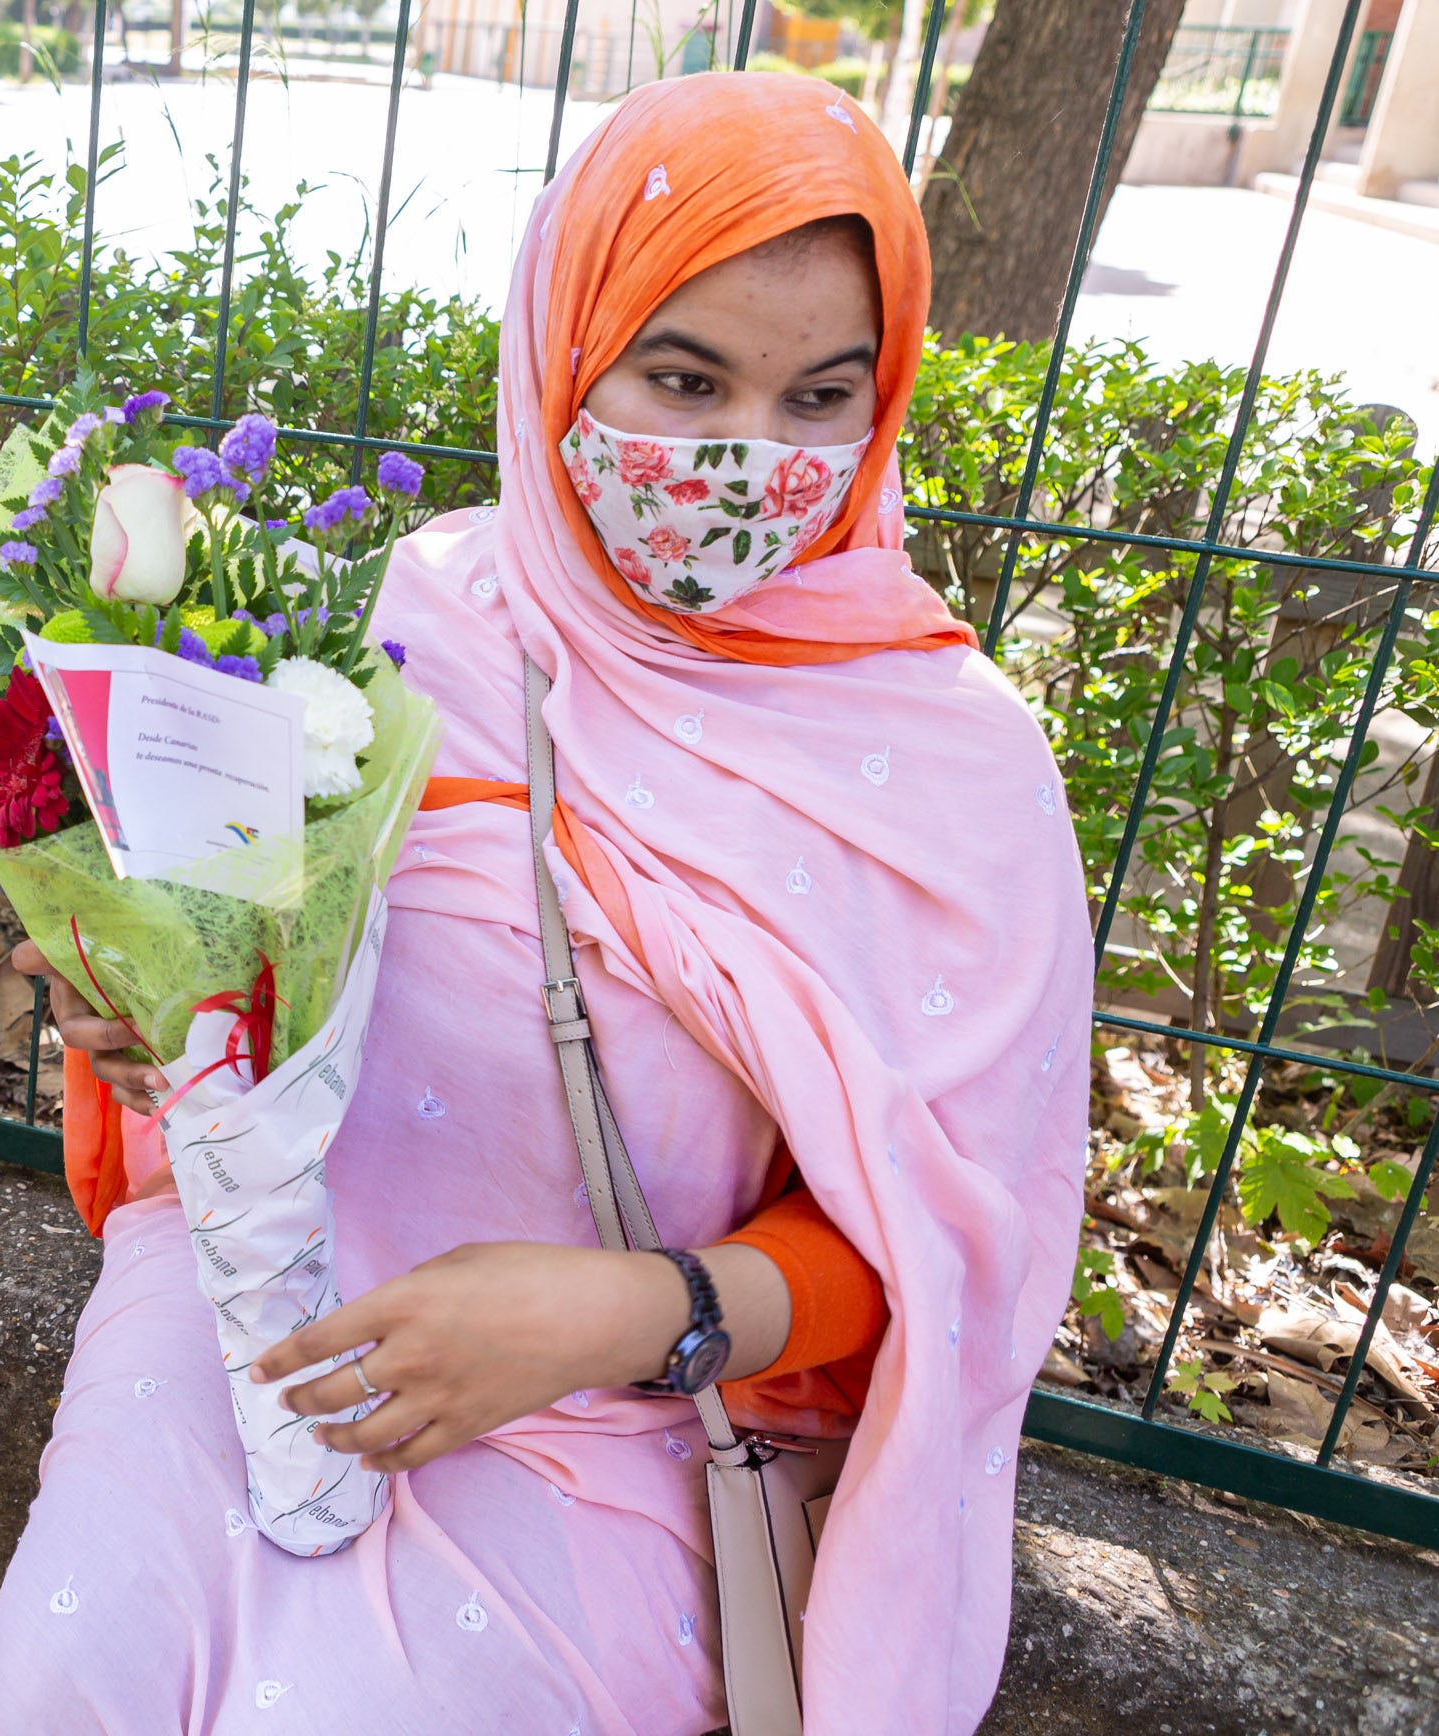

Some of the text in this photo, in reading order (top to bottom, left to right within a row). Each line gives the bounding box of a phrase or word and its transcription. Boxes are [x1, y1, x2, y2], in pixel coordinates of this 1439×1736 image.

[141, 695, 179, 710] Presidente
[180, 704, 187, 713] de
[188, 706, 195, 716] la
[138, 732, 162, 744] Desde
[136, 752, 143, 760] te
[145, 752, 182, 765] deseamos
[183, 761, 198, 769] una
[199, 765, 222, 776] pronta
